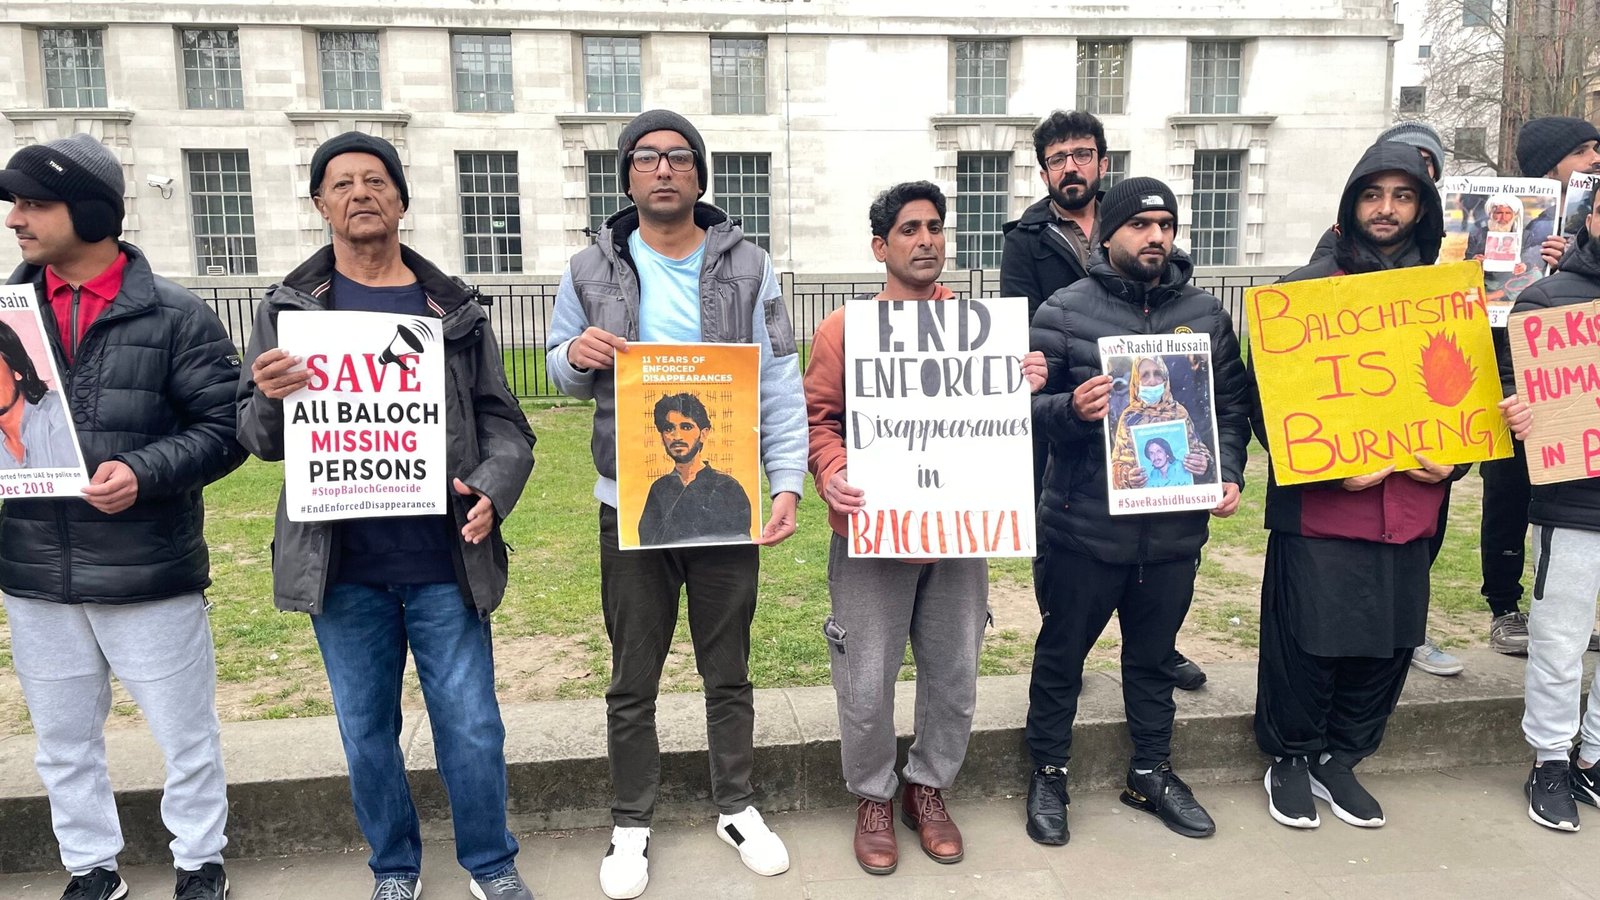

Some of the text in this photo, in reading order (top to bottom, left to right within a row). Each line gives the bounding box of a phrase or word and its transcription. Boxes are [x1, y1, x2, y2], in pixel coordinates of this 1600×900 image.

[1469, 183, 1499, 194] Jumma
[1502, 184, 1526, 194] Khan
[878, 299, 992, 352] END
[1254, 286, 1489, 354] BALOCHISTAN
[1127, 340, 1163, 354] Rashid
[1166, 338, 1209, 353] Hussain
[642, 365, 696, 373] ENFORCED
[655, 355, 689, 364] YEARS
[691, 355, 706, 364] OF
[306, 352, 421, 393] SAVE
[642, 373, 733, 383] DISAPPEARANCES
[854, 355, 1024, 399] ENFORCED
[1314, 351, 1397, 400] IS
[337, 401, 439, 425] BALOCH
[311, 429, 418, 454] MISSING
[851, 410, 1030, 452] Disappearances
[1283, 408, 1494, 475] BURNING
[1541, 442, 1566, 469] IN
[18, 472, 32, 480] from
[46, 472, 54, 480] by
[55, 471, 72, 480] police
[309, 458, 427, 483] PERSONS
[917, 464, 945, 489] in
[22, 481, 54, 495] 2018
[311, 483, 422, 498] #StopBalochGenocide
[300, 500, 436, 515] #EndEnforcedDisappearances
[1118, 492, 1217, 509] #SaveRashidHussain
